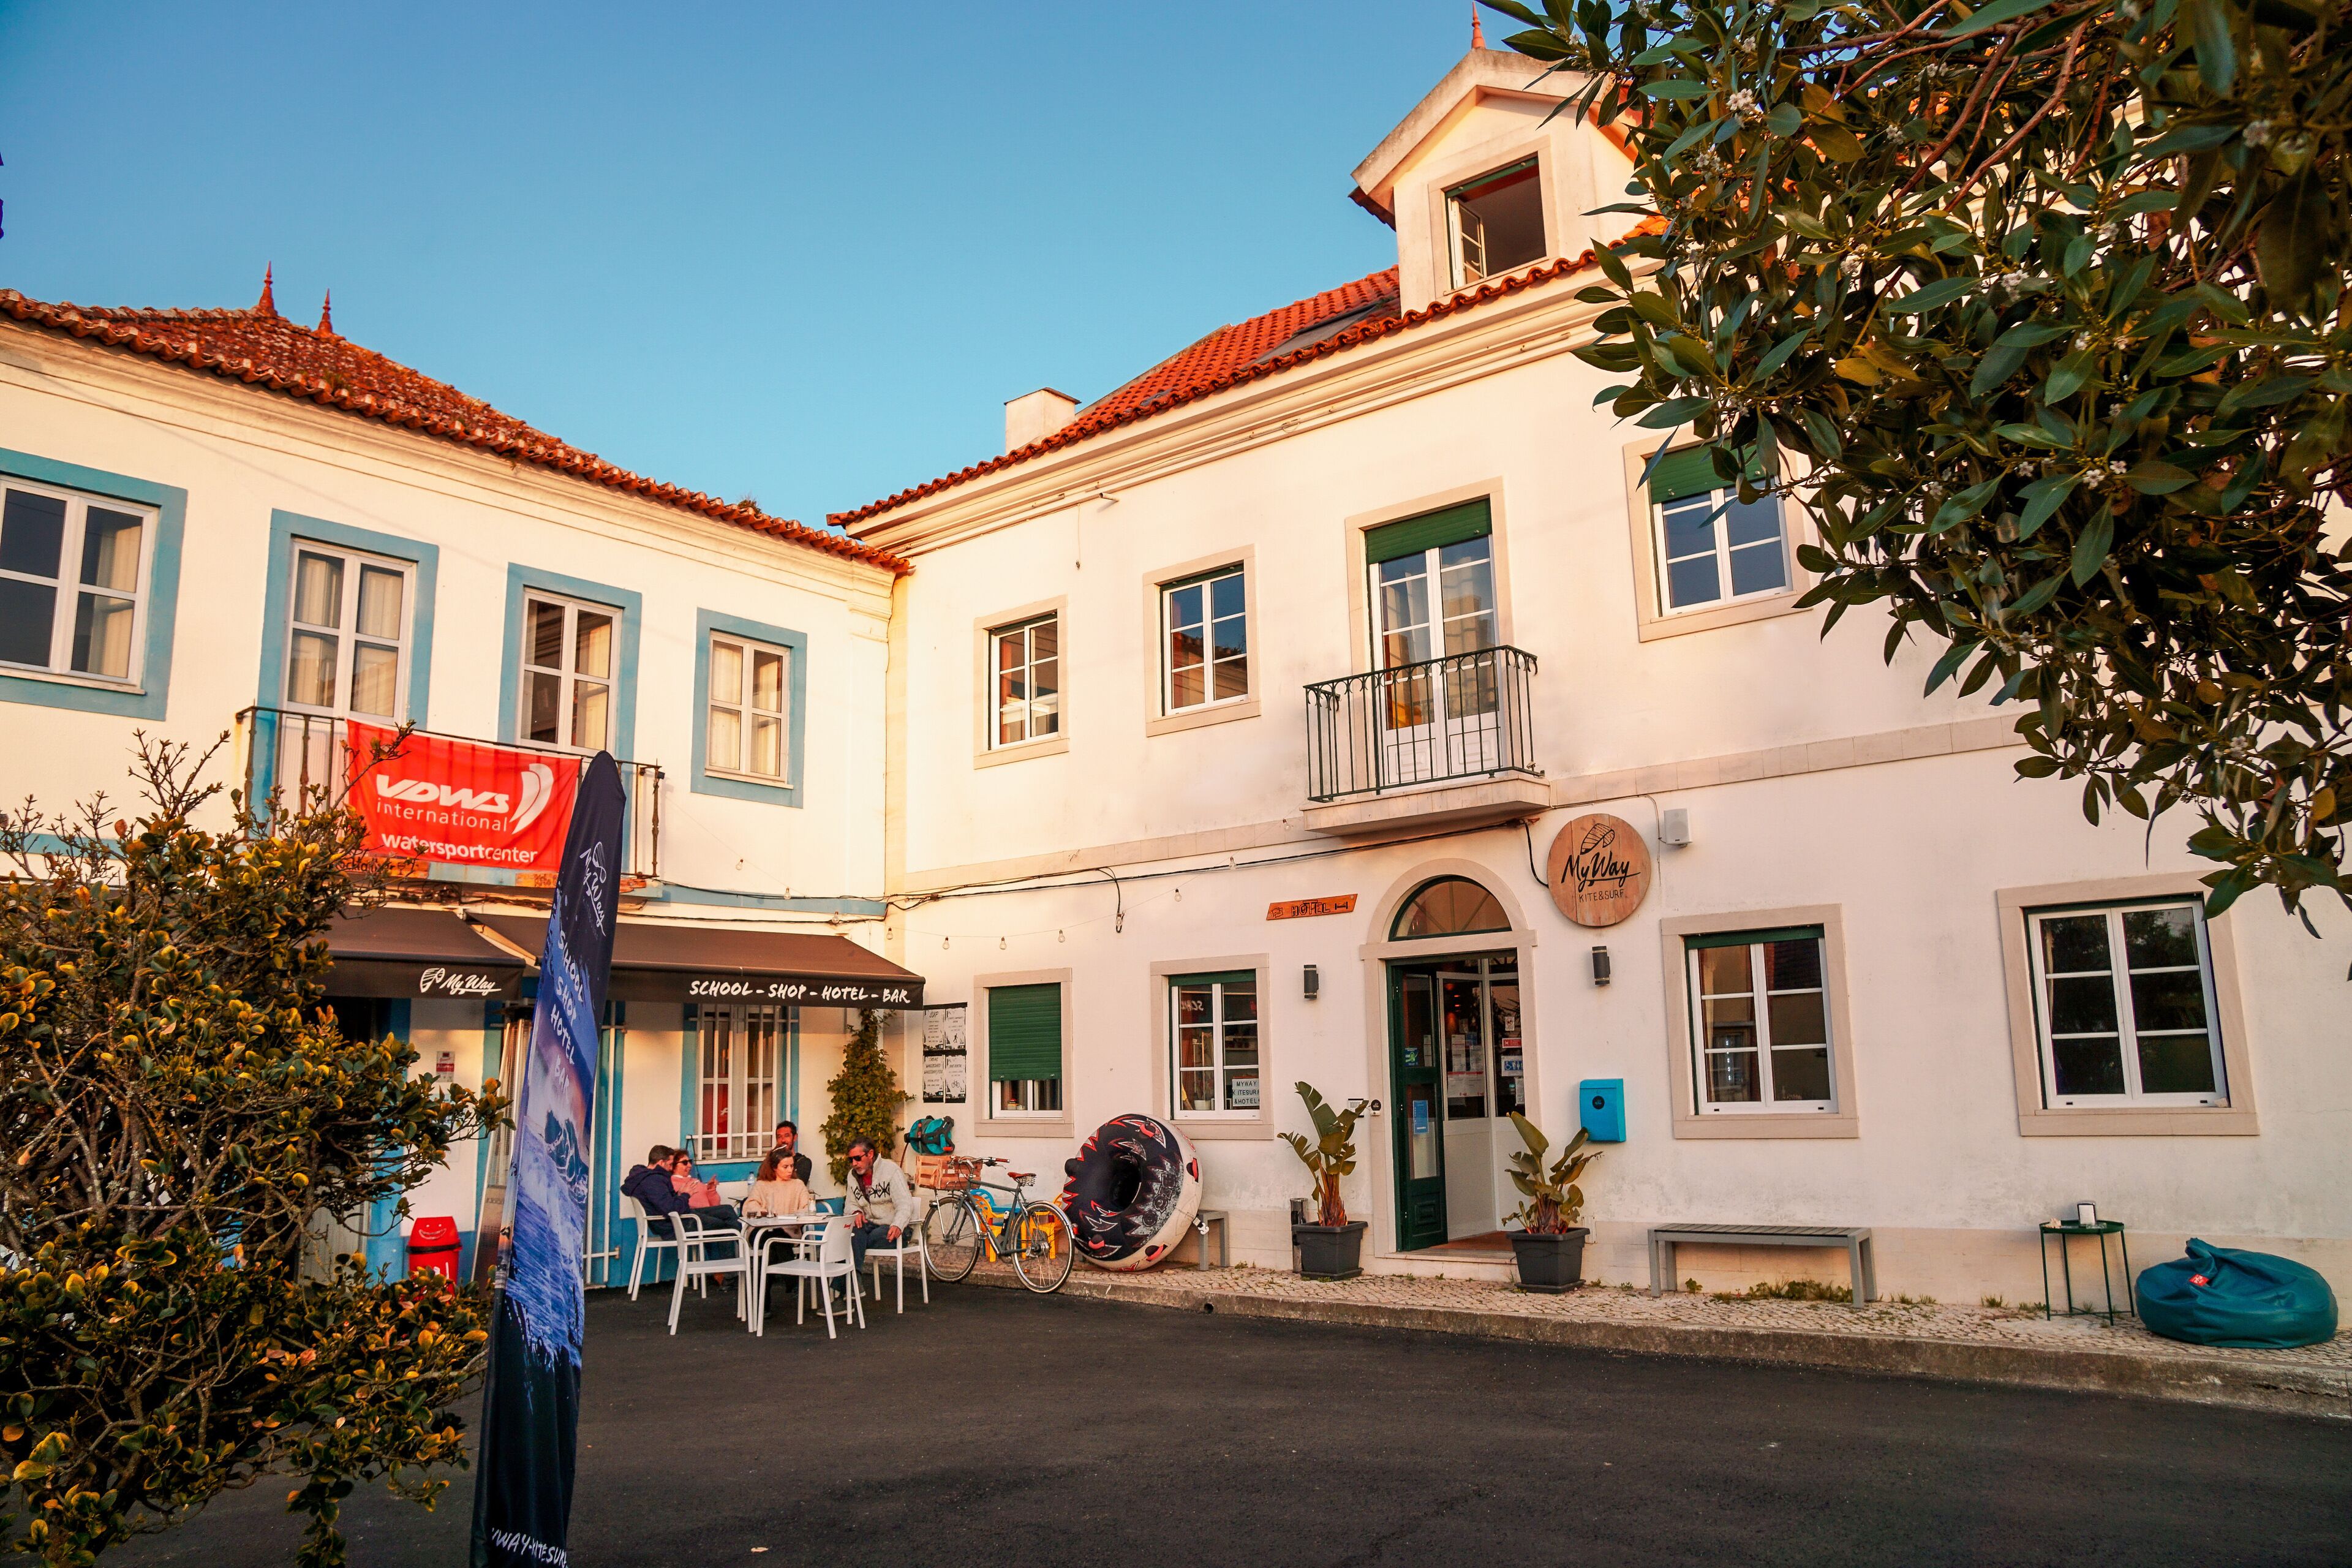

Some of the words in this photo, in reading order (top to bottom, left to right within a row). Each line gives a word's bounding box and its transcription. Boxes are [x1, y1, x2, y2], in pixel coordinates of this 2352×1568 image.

[376, 774, 510, 813] VDWS
[377, 797, 507, 832] international
[381, 833, 538, 863] watersportcenter
[1291, 900, 1331, 917] HOTEL
[1578, 889, 1624, 903] KITE&SURF
[689, 980, 753, 996] SCHOOL
[768, 984, 807, 1000] SHOP
[821, 986, 869, 1001] HOTEL
[883, 988, 911, 1004] BAR
[551, 1004, 575, 1065] HOTEL
